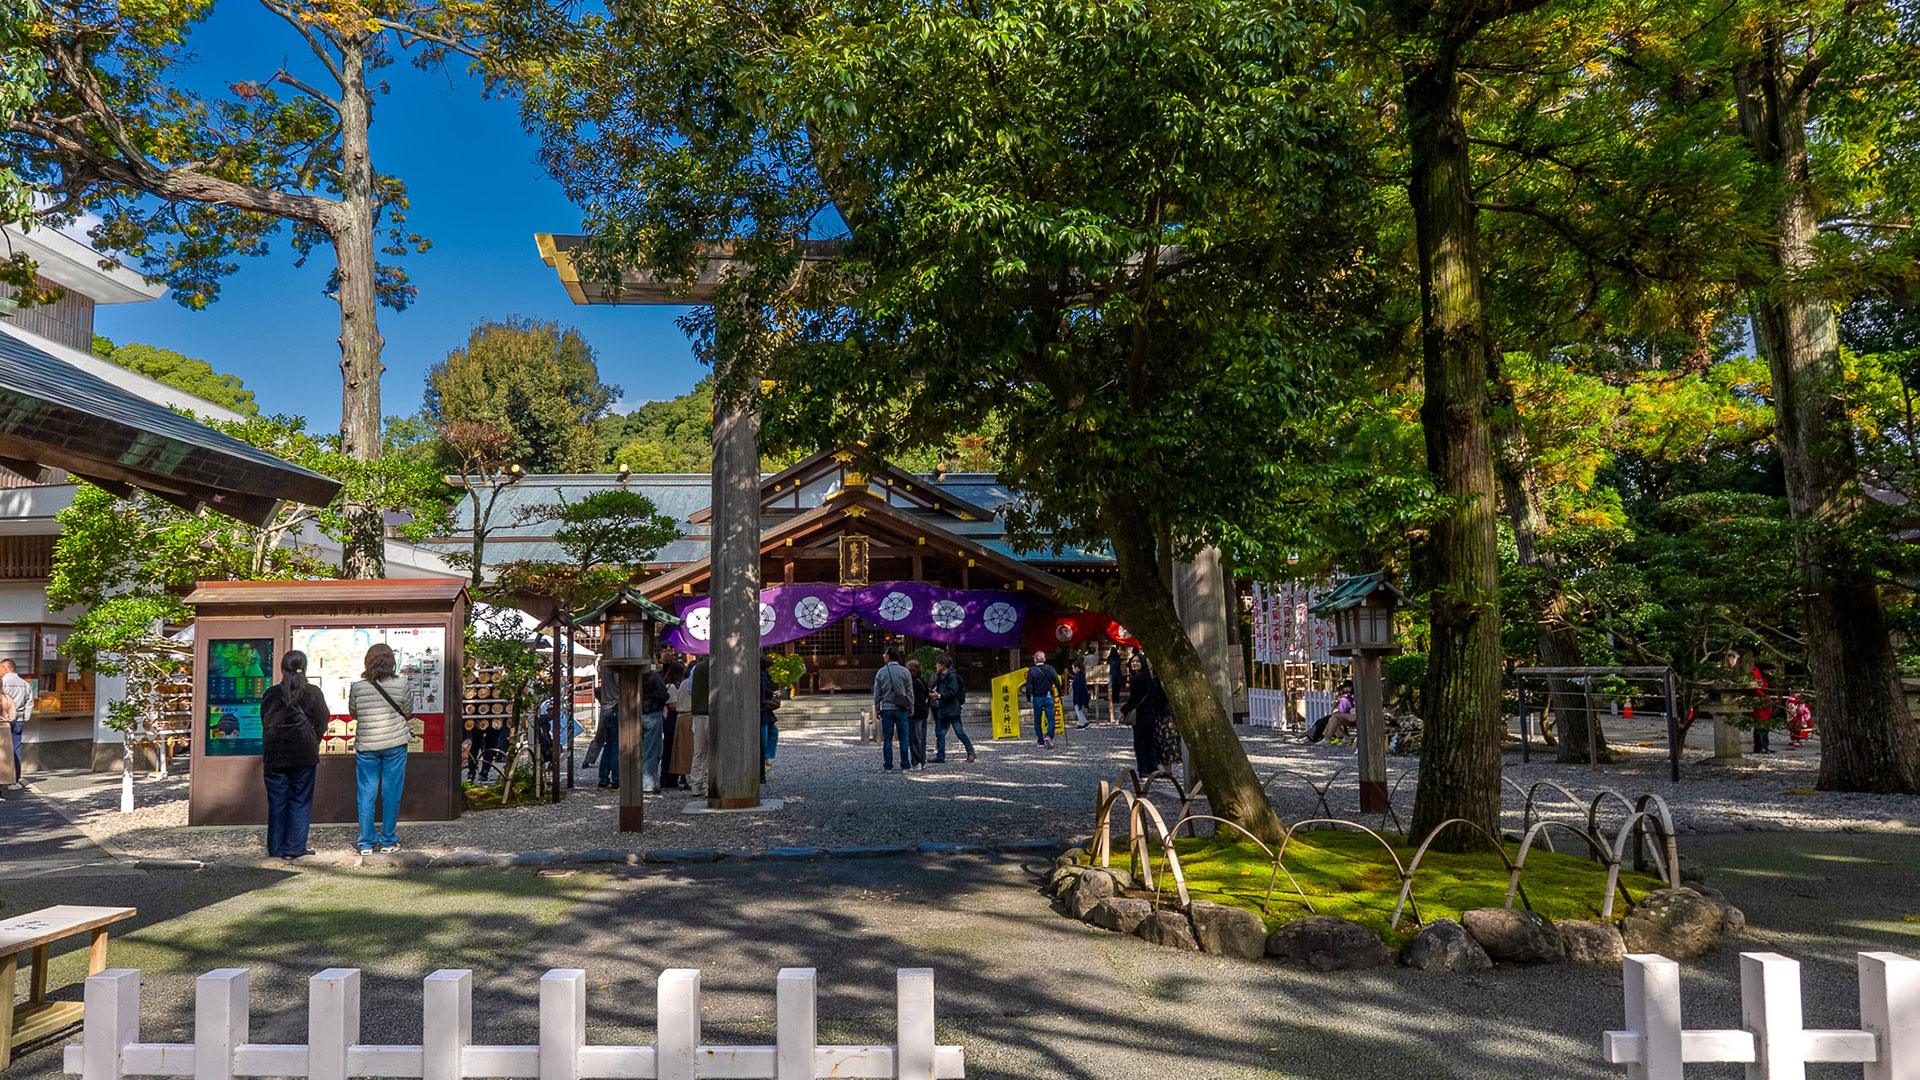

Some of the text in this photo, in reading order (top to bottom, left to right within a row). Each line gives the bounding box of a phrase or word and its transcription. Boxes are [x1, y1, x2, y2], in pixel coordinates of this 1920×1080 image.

[1001, 684, 1012, 734] 猿田彦神社
